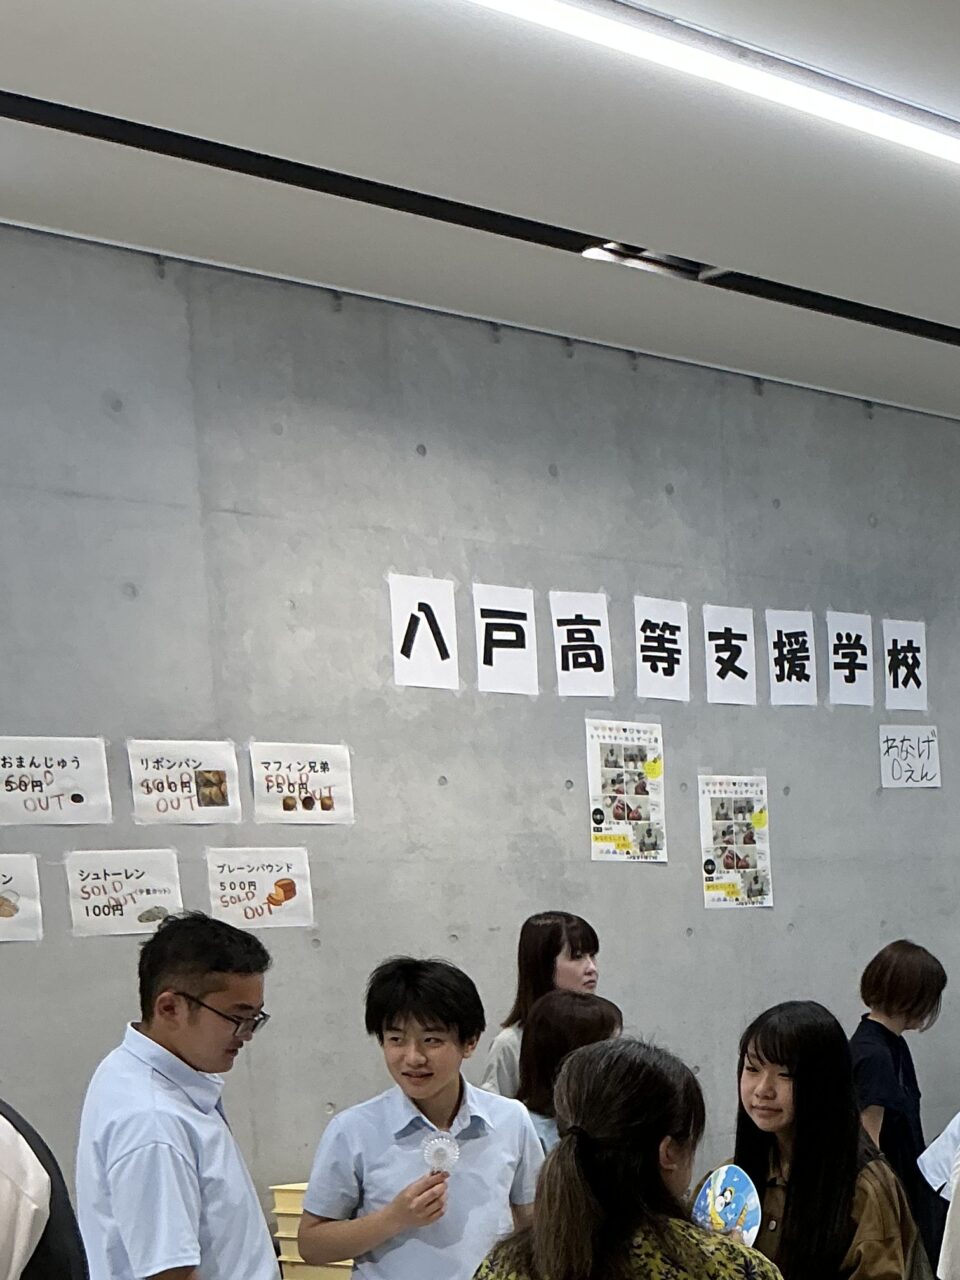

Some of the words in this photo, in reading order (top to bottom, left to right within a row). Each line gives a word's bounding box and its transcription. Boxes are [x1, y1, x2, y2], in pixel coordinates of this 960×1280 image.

[400, 602, 922, 689] 八戸高等支援学校
[883, 730, 936, 761] わなげ
[1, 756, 80, 769] おまんじゅう
[261, 761, 330, 773] マフィン兄弟
[24, 794, 64, 812] OUT
[156, 795, 197, 813] OUT
[79, 868, 145, 881] シュトーレン
[220, 881, 256, 891] 500円
[220, 891, 255, 907] SOLD
[85, 904, 123, 917] 100円
[244, 902, 273, 919] OUT
